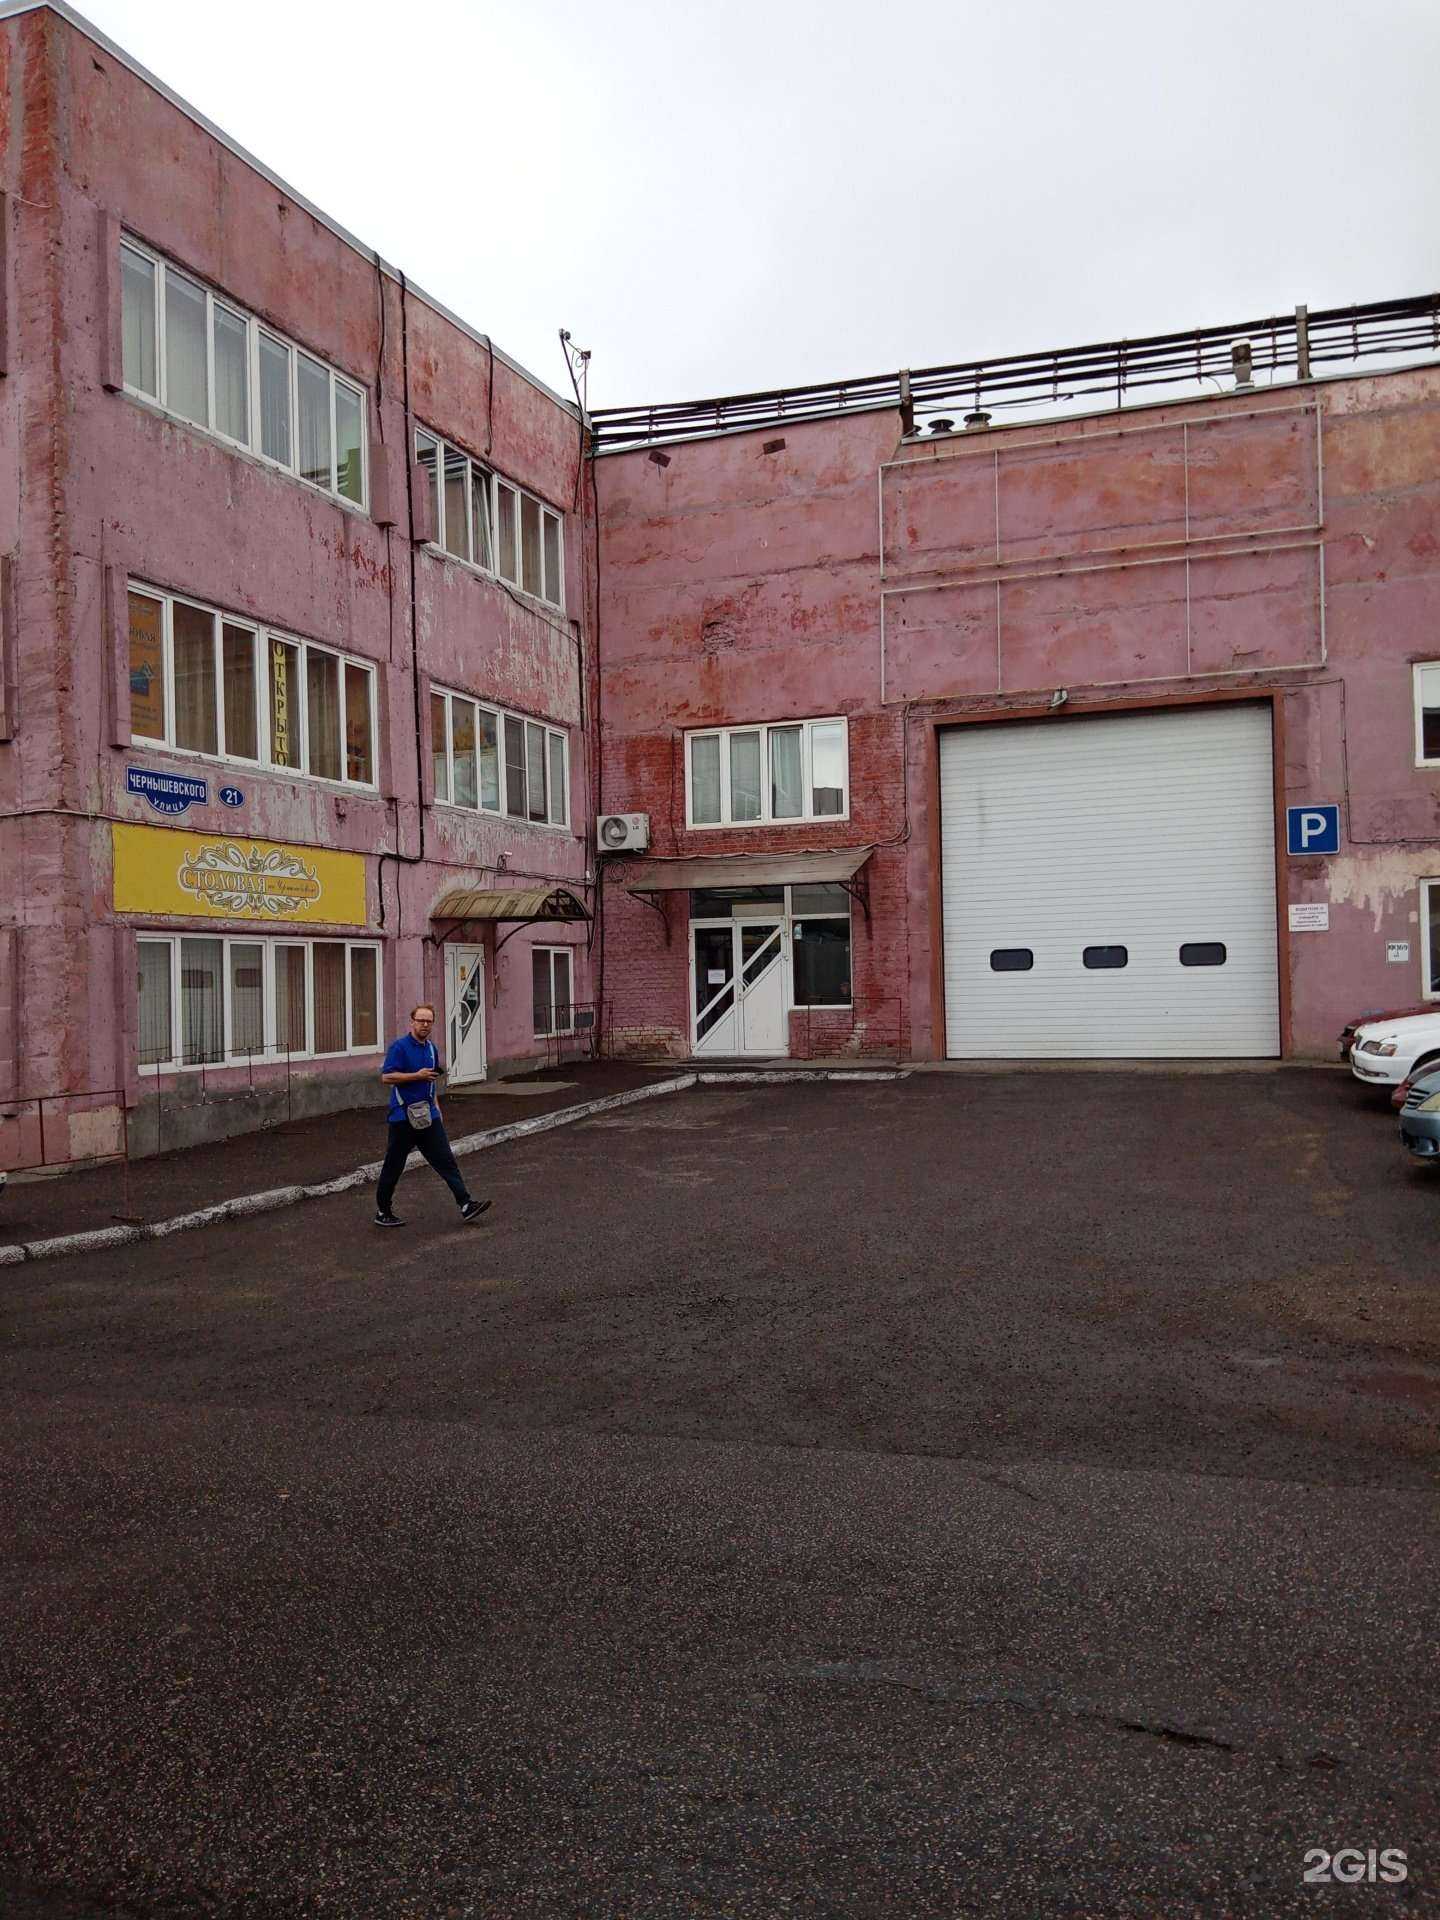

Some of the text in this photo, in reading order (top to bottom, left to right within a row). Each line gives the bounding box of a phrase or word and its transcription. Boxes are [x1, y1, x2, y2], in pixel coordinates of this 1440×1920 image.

[273, 641, 287, 767] ОТКРЫТО
[129, 773, 205, 798] ЧЕРНЫШЕВСКОГО
[226, 789, 238, 805] 21
[153, 797, 184, 811] УЛИЦА
[1301, 813, 1327, 848] P
[182, 869, 266, 893] СТОЛОВАЯ
